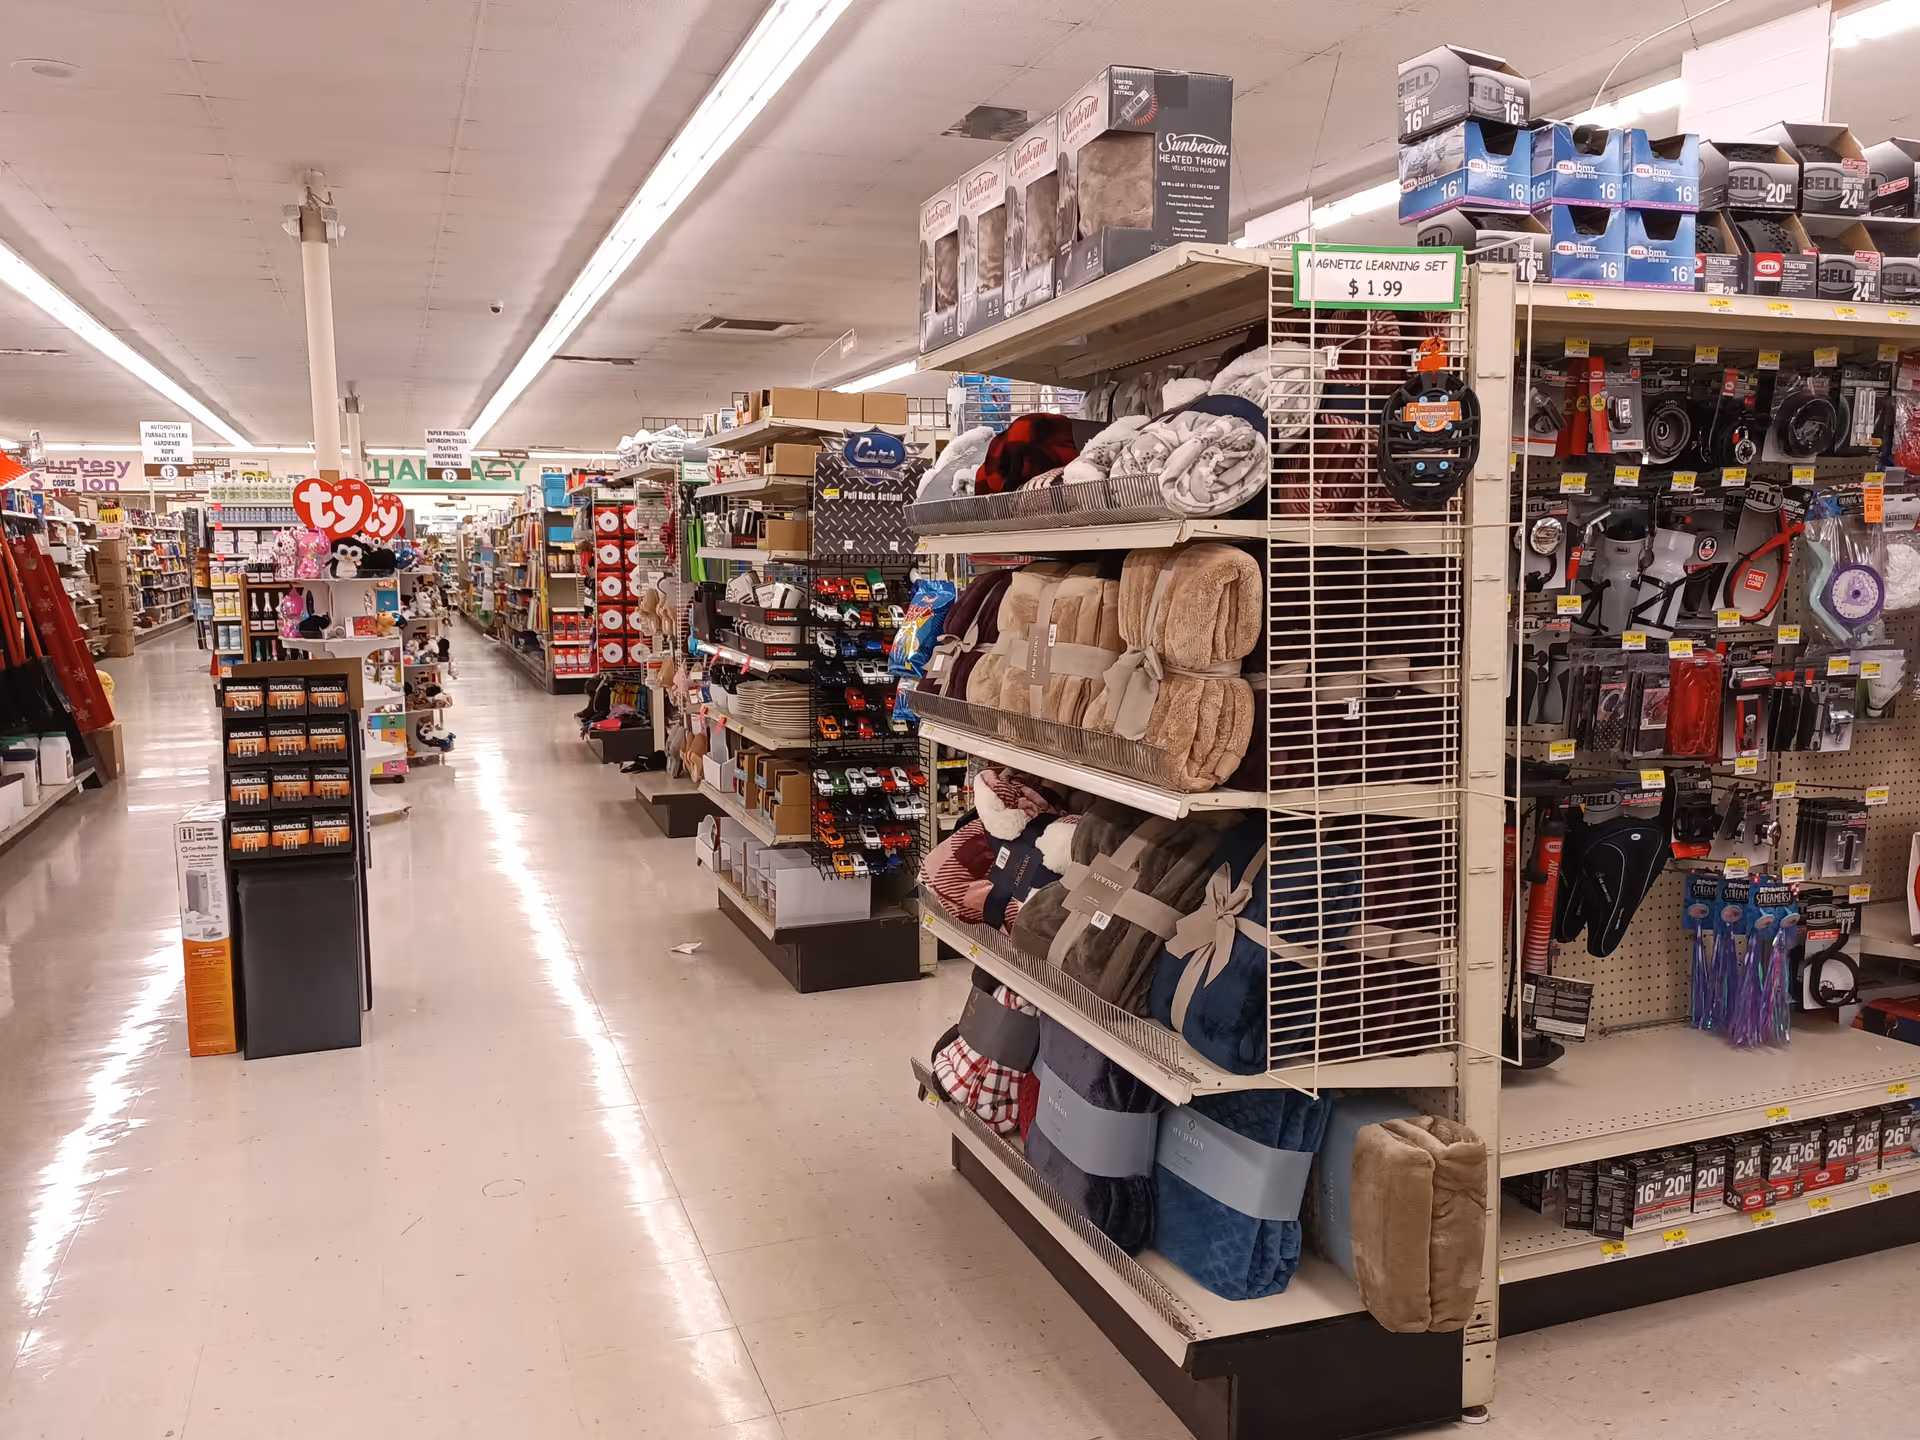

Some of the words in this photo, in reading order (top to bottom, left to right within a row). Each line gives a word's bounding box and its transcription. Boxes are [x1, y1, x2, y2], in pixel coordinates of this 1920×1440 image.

[1398, 71, 1434, 99] BELL
[1062, 95, 1099, 142] Sunbeam
[1404, 103, 1430, 134] 16"
[1504, 101, 1525, 126] 16"
[1010, 136, 1048, 177] Sunbeam
[1159, 154, 1192, 165] HEATED
[1195, 156, 1226, 167] THROW
[1172, 165, 1199, 173] VELVETEEN
[1487, 162, 1505, 172] bmx
[1576, 161, 1596, 173] bmx
[1653, 165, 1672, 176] bmx
[1417, 172, 1436, 185] bmx
[1804, 176, 1842, 191] BELL
[962, 171, 999, 207] Sunbeam
[1440, 177, 1463, 200] 16"
[1508, 182, 1529, 201] 16"
[1599, 182, 1621, 200] 16"
[1675, 185, 1697, 202] 16"
[1729, 176, 1767, 191] BELL
[1765, 183, 1792, 203] 20"
[1840, 189, 1864, 209] 24"
[1577, 243, 1597, 253] bmx
[1648, 246, 1667, 258] bmx
[1365, 259, 1420, 272] LEARNING
[1424, 260, 1448, 272] SET
[1518, 259, 1543, 282] 16"
[1600, 261, 1622, 279] 16"
[1706, 258, 1730, 266] TRACTION
[1761, 263, 1777, 271] BELL
[1670, 265, 1693, 283] 16"
[1819, 269, 1853, 283] BELL
[1882, 271, 1918, 286] BELL
[1348, 278, 1359, 298] $
[1367, 279, 1403, 297] 1.99
[1852, 281, 1875, 302] 24"
[1642, 379, 1663, 389] BELL
[1659, 426, 1665, 434] 1
[854, 436, 897, 463] Cars
[50, 457, 131, 478] urtesy
[164, 468, 175, 478] 13
[367, 458, 527, 481] HAACY
[445, 471, 454, 480] 12
[30, 472, 119, 492] Sion
[52, 479, 75, 487] COPIES
[843, 490, 858, 500] Pull
[858, 491, 876, 501] Back
[877, 492, 903, 502] Action!
[1674, 497, 1696, 507] BELL
[1747, 489, 1776, 507] BELL
[299, 482, 364, 534] ty
[1526, 502, 1547, 513] BELL
[1795, 506, 1805, 515] LOCK
[364, 503, 398, 537] ty
[1884, 513, 1914, 521] BASKETBALL
[1747, 579, 1762, 588] CORE
[1749, 573, 1765, 583] STEEL
[1030, 634, 1039, 679] NEWPORT
[1731, 652, 1749, 662] BELL
[232, 777, 265, 785] DURACELL
[1678, 781, 1696, 792] BELL
[1585, 793, 1618, 807] BELL
[233, 825, 266, 833] DURACELL
[273, 823, 306, 831] DURACELL
[314, 819, 347, 827] DURACELL
[1549, 859, 1559, 877] AIR
[1091, 872, 1123, 892] NEWPORT
[1756, 893, 1791, 905] STREAMERS!
[1808, 909, 1836, 920] BELL
[1048, 1096, 1068, 1119] HUDSON
[1172, 1126, 1205, 1151] HUDSON
[1856, 1131, 1880, 1153] 26"
[1884, 1126, 1911, 1148] 26"
[1799, 1141, 1820, 1163] 26"
[1828, 1136, 1853, 1159] 26"
[1735, 1156, 1761, 1180] 24"
[1771, 1153, 1799, 1176] 24"
[1844, 1165, 1859, 1177] 26"
[1664, 1174, 1692, 1198] 20"
[1697, 1166, 1724, 1190] 20"
[1637, 1182, 1661, 1205] 16"
[1765, 1191, 1777, 1201] 24"
